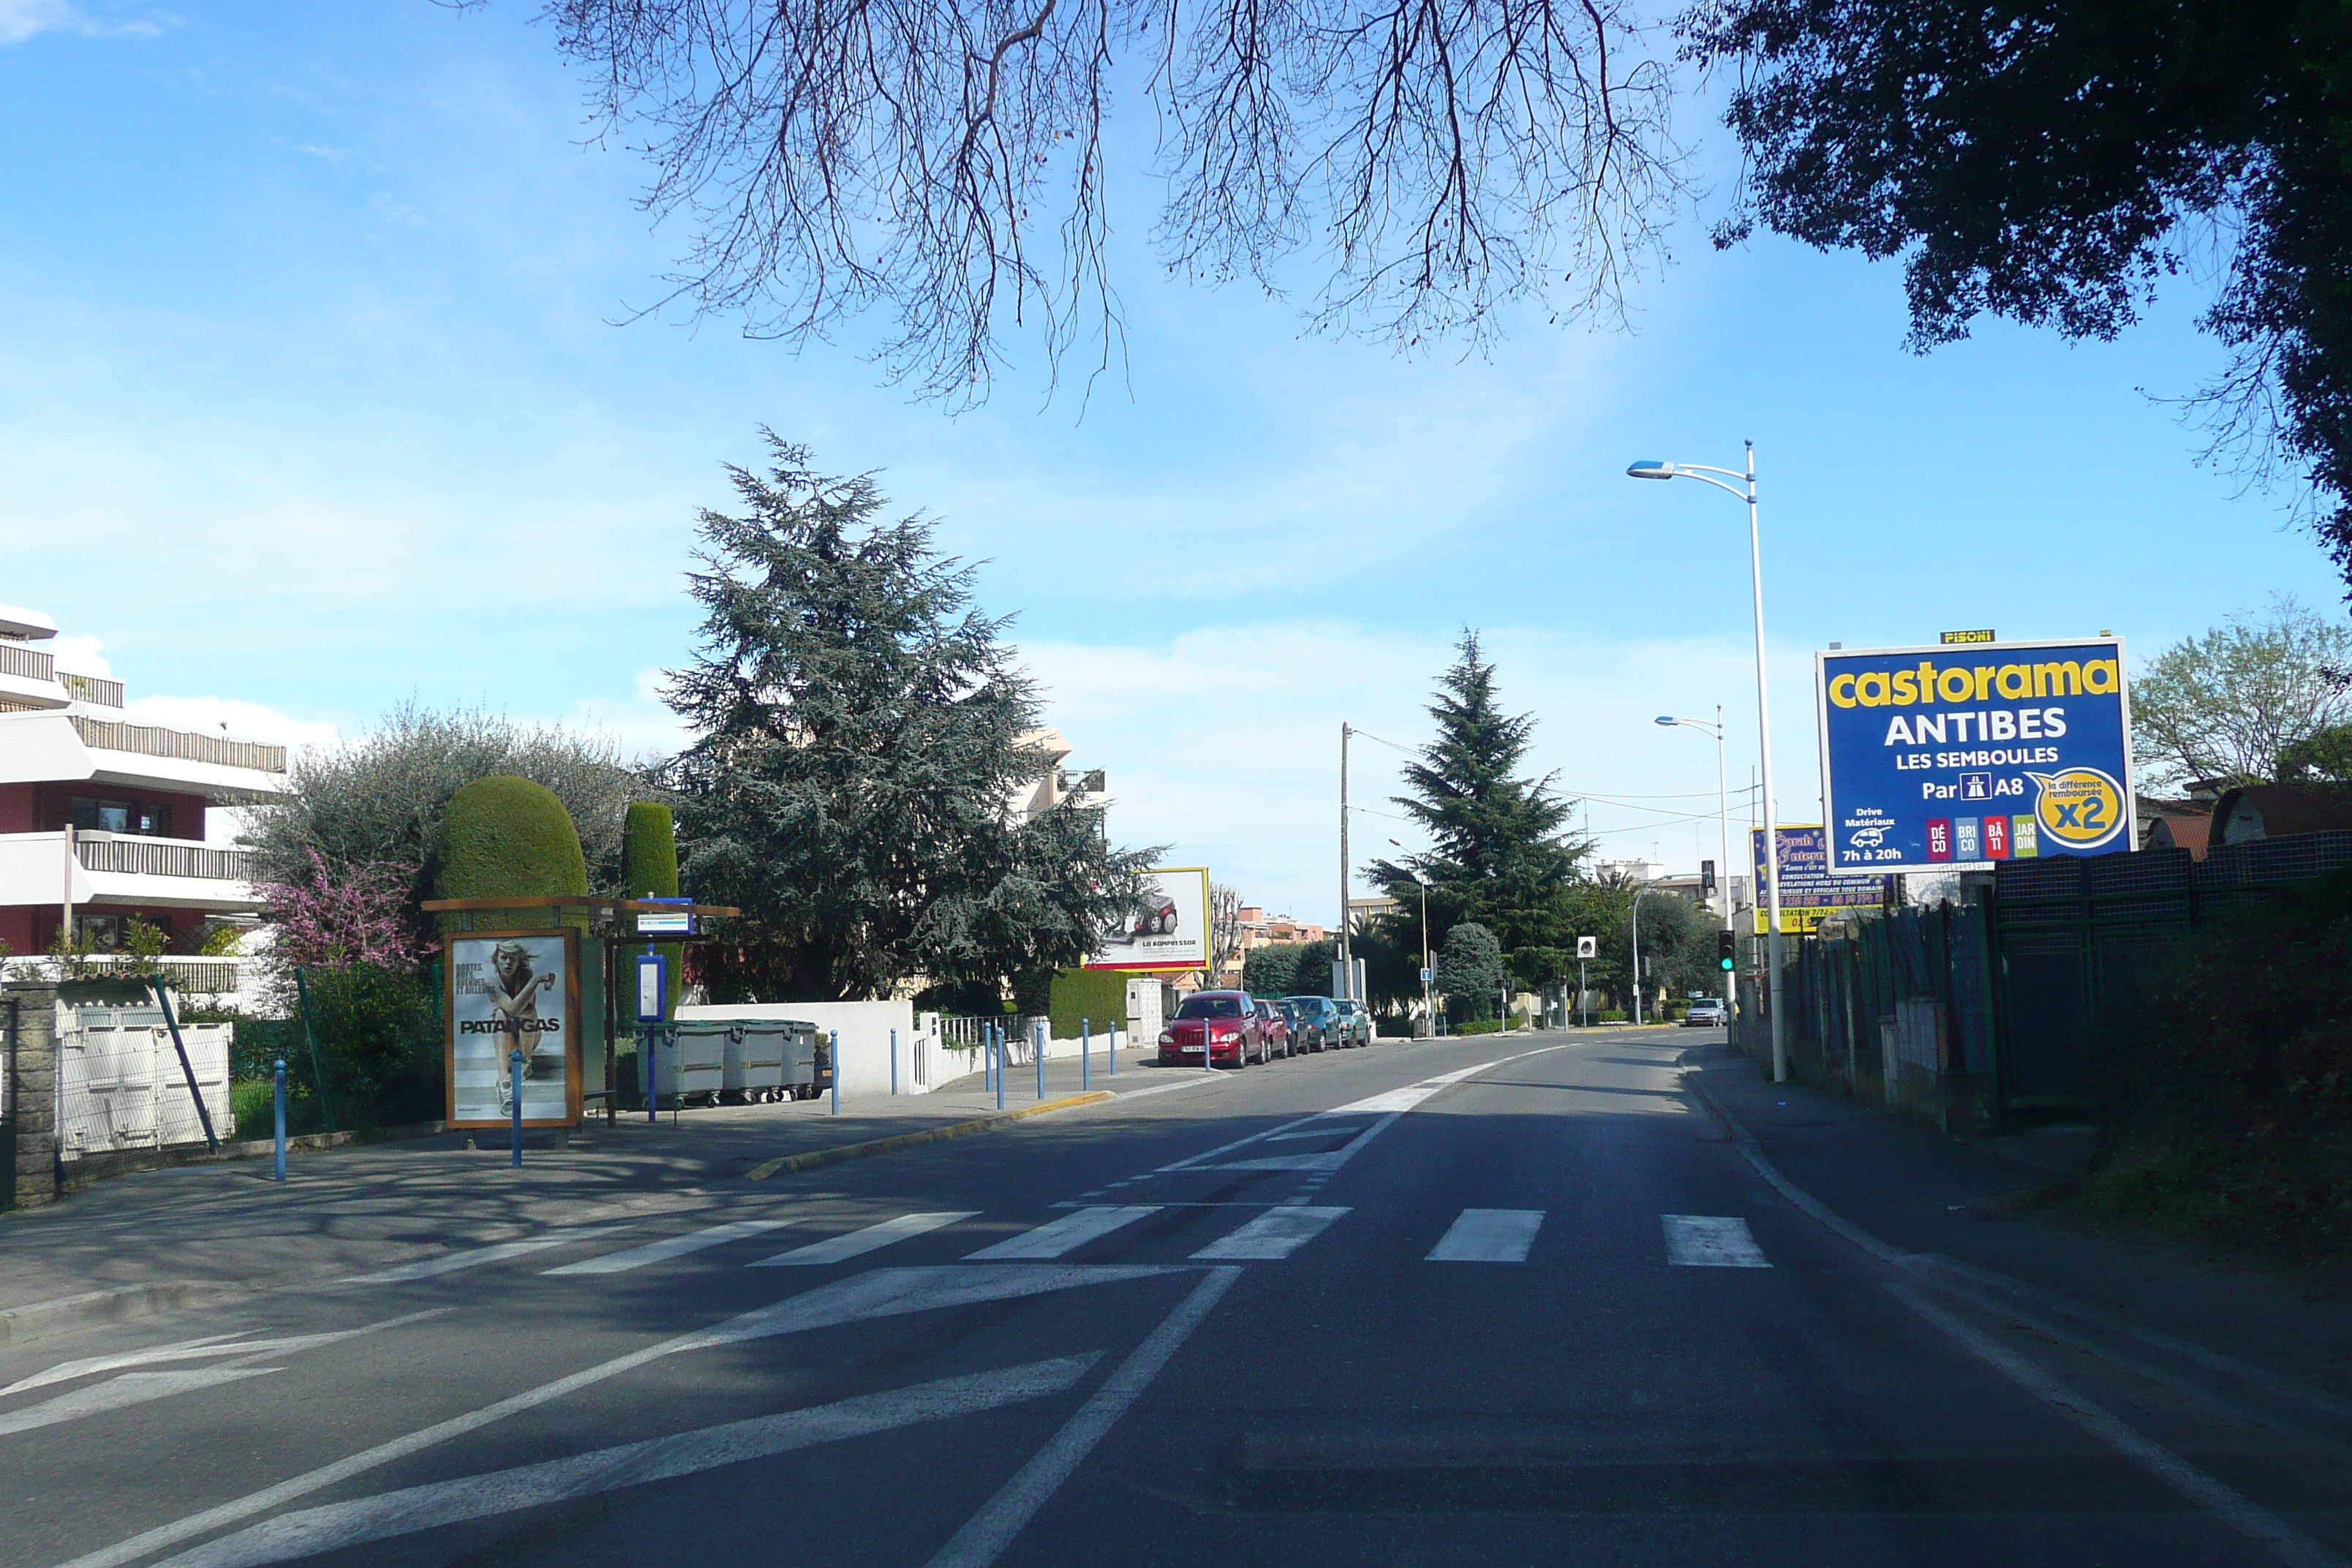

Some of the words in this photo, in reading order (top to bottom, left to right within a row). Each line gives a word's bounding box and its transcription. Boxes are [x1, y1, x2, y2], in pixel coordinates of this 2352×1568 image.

[1829, 659, 2119, 708] castorama
[1884, 708, 2067, 746] ANTIBES
[1896, 753, 1931, 770] LES
[1936, 747, 2059, 767] SEMBOULES
[1923, 783, 1957, 799] Par
[1994, 778, 2024, 796] A8
[2059, 780, 2103, 789] différence
[2048, 788, 2103, 798] remboursée
[1855, 808, 1883, 816] Drive
[1845, 818, 1896, 828] Matériaux
[1989, 821, 2003, 837] BÂ
[2016, 823, 2035, 836] JAR
[1931, 824, 1945, 840] DÉ
[1959, 826, 1976, 838] BRI
[1932, 840, 1946, 852] CO
[1961, 839, 1975, 851] CO
[1991, 837, 2002, 851] TI
[2017, 836, 2035, 849] DIN
[1842, 851, 1861, 862] 7h
[1864, 850, 1872, 860] à
[1875, 848, 1902, 860] 20h
